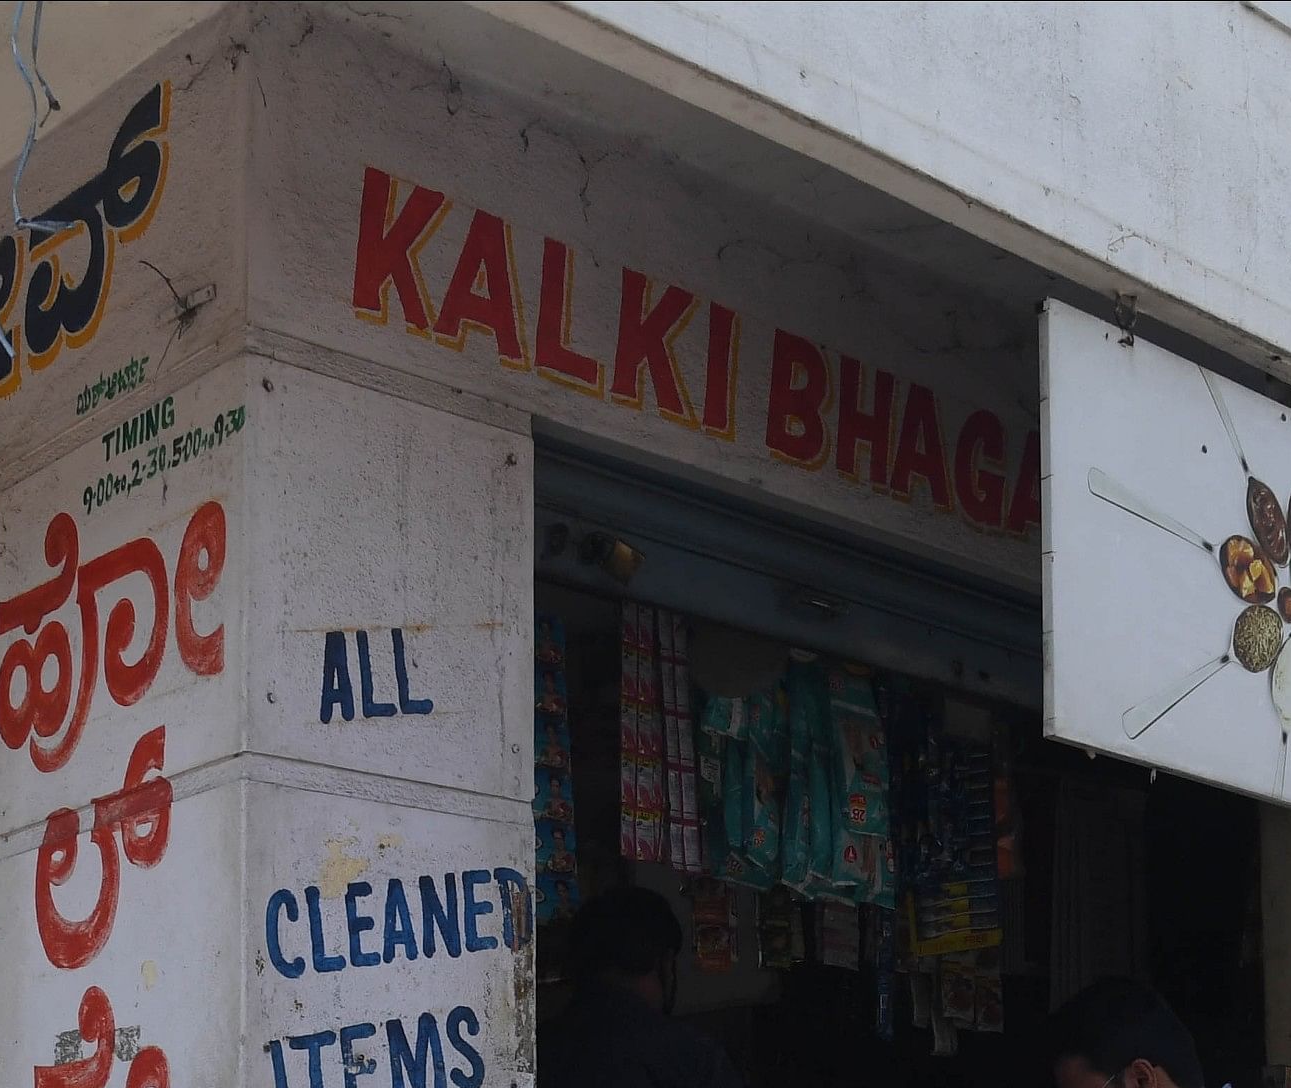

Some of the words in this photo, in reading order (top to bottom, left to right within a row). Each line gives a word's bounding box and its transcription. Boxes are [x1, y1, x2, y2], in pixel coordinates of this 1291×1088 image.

[352, 167, 741, 442] KALKI
[102, 396, 175, 462] TIMING
[319, 627, 434, 724] ALL
[265, 866, 533, 979] CLEANED
